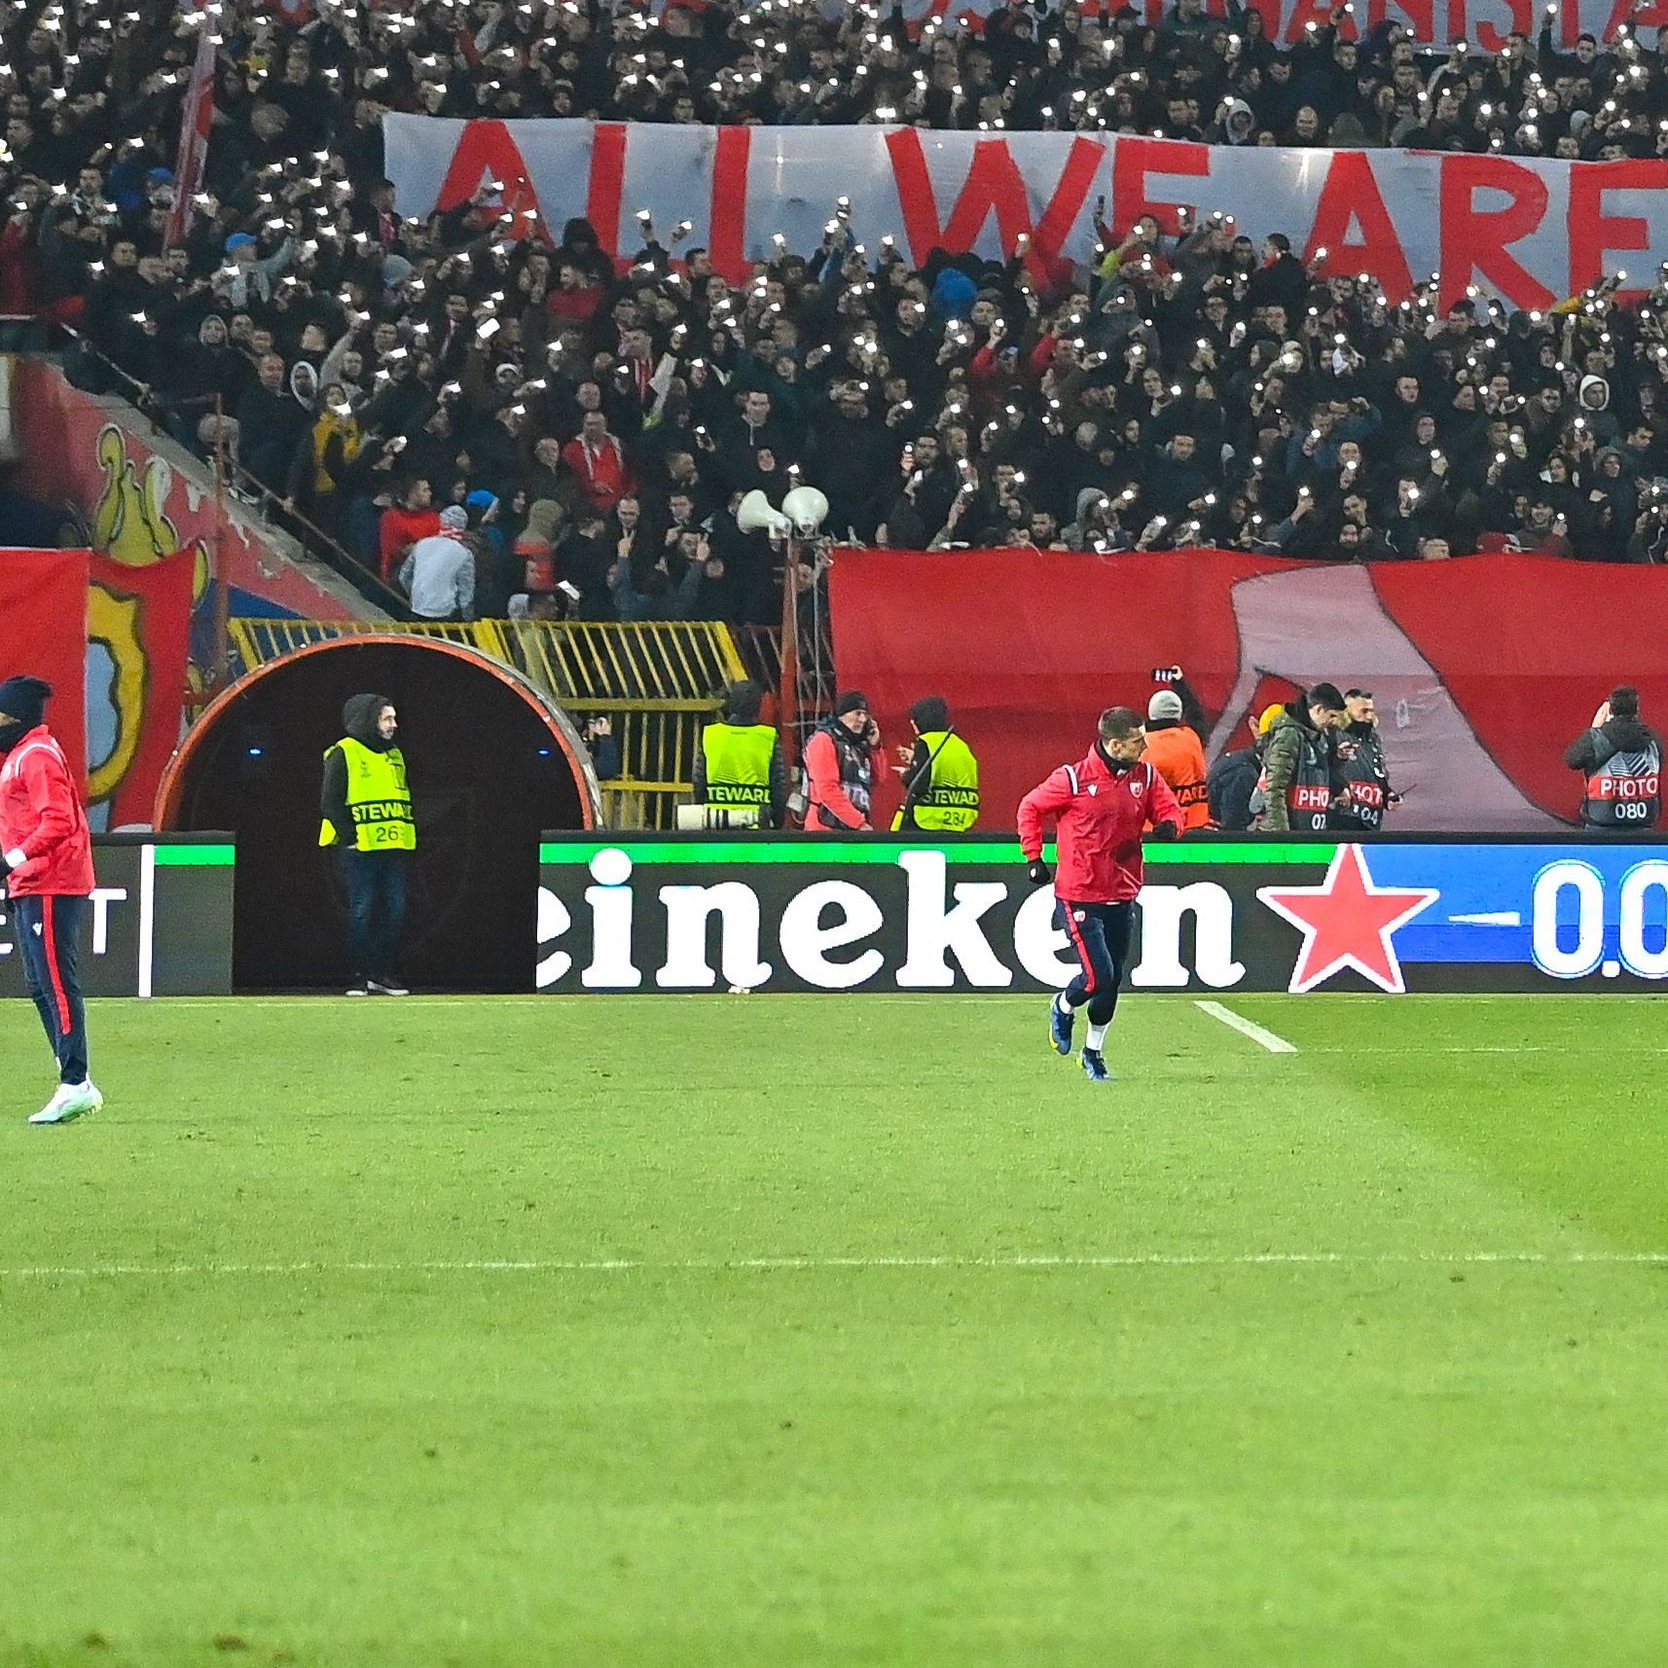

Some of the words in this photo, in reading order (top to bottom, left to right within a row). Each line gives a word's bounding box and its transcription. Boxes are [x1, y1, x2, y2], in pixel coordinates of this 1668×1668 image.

[885, 126, 1211, 292] WE
[1600, 778, 1658, 796] PHOTO
[1615, 802, 1648, 820] 080
